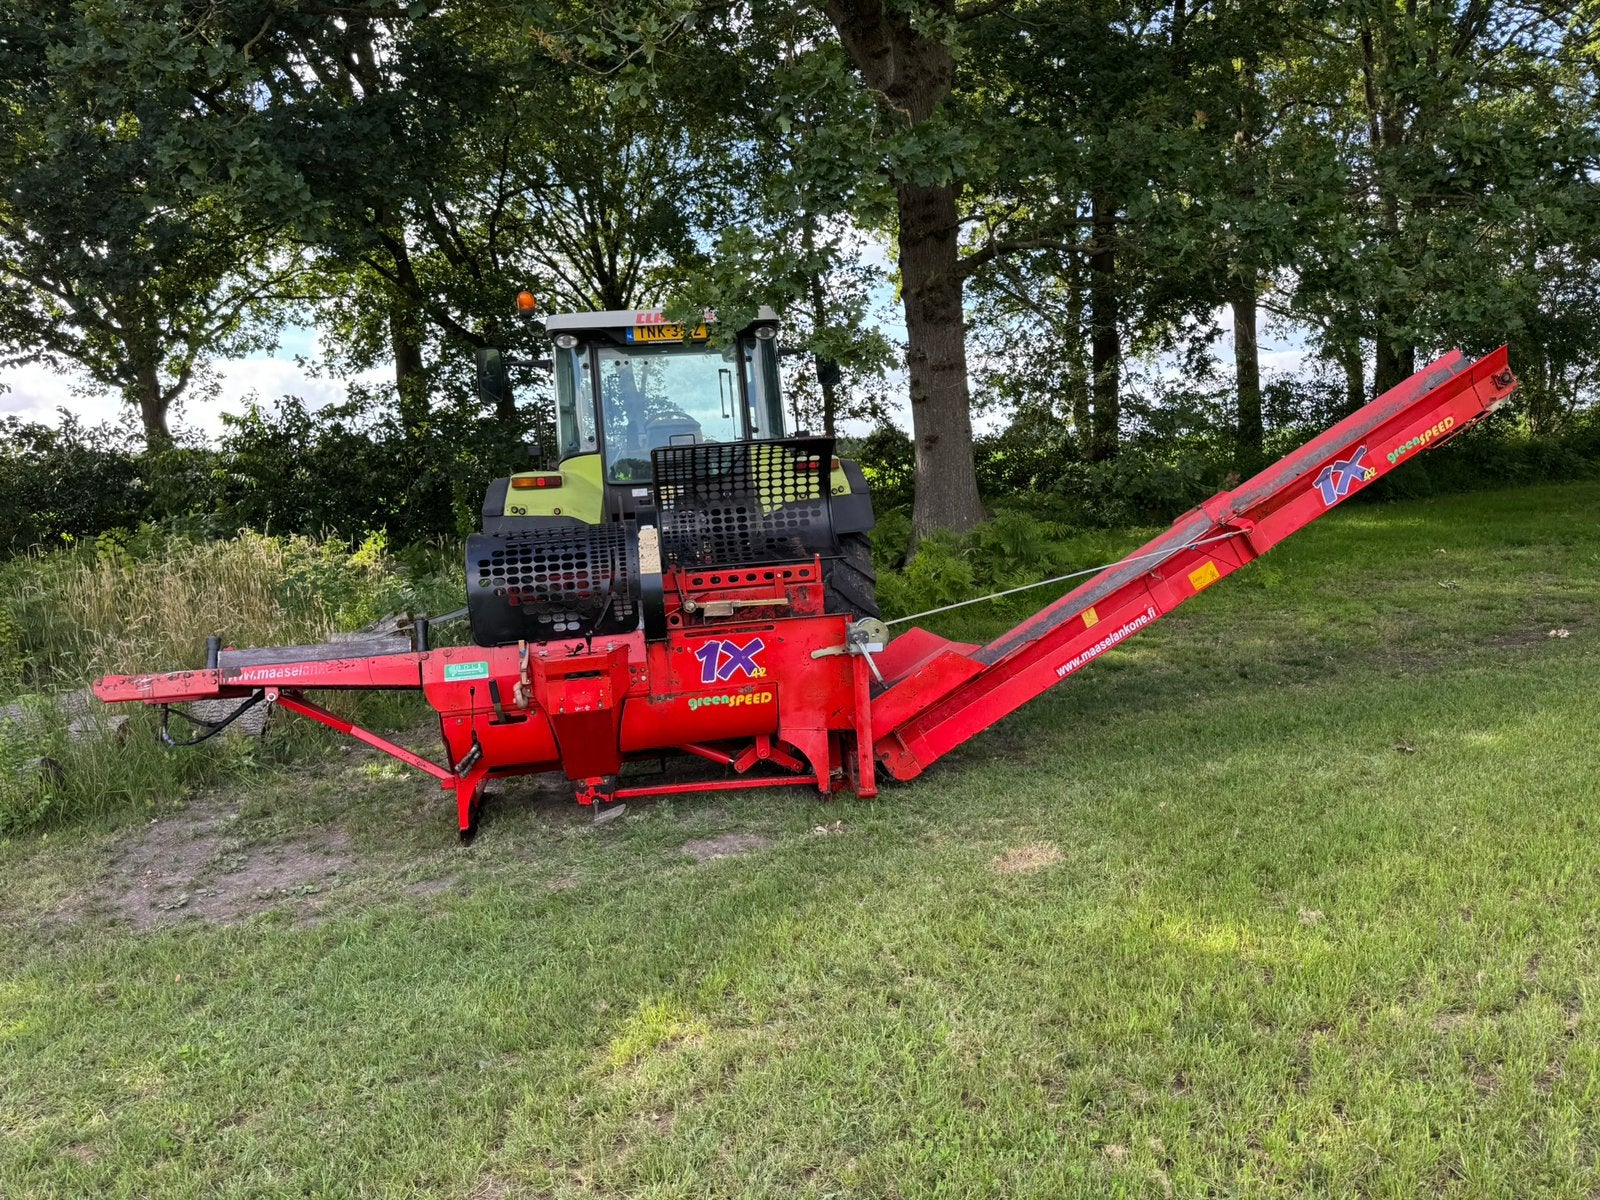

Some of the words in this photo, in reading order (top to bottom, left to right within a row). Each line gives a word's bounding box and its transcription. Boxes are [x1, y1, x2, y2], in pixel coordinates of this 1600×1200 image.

[1387, 416, 1455, 463] greenSPEED
[1312, 445, 1370, 506] 1X
[695, 638, 765, 684] 1X
[751, 668, 767, 678] 42
[1056, 606, 1156, 677] www.maaselankone.fi
[688, 691, 772, 711] greenSPEED
